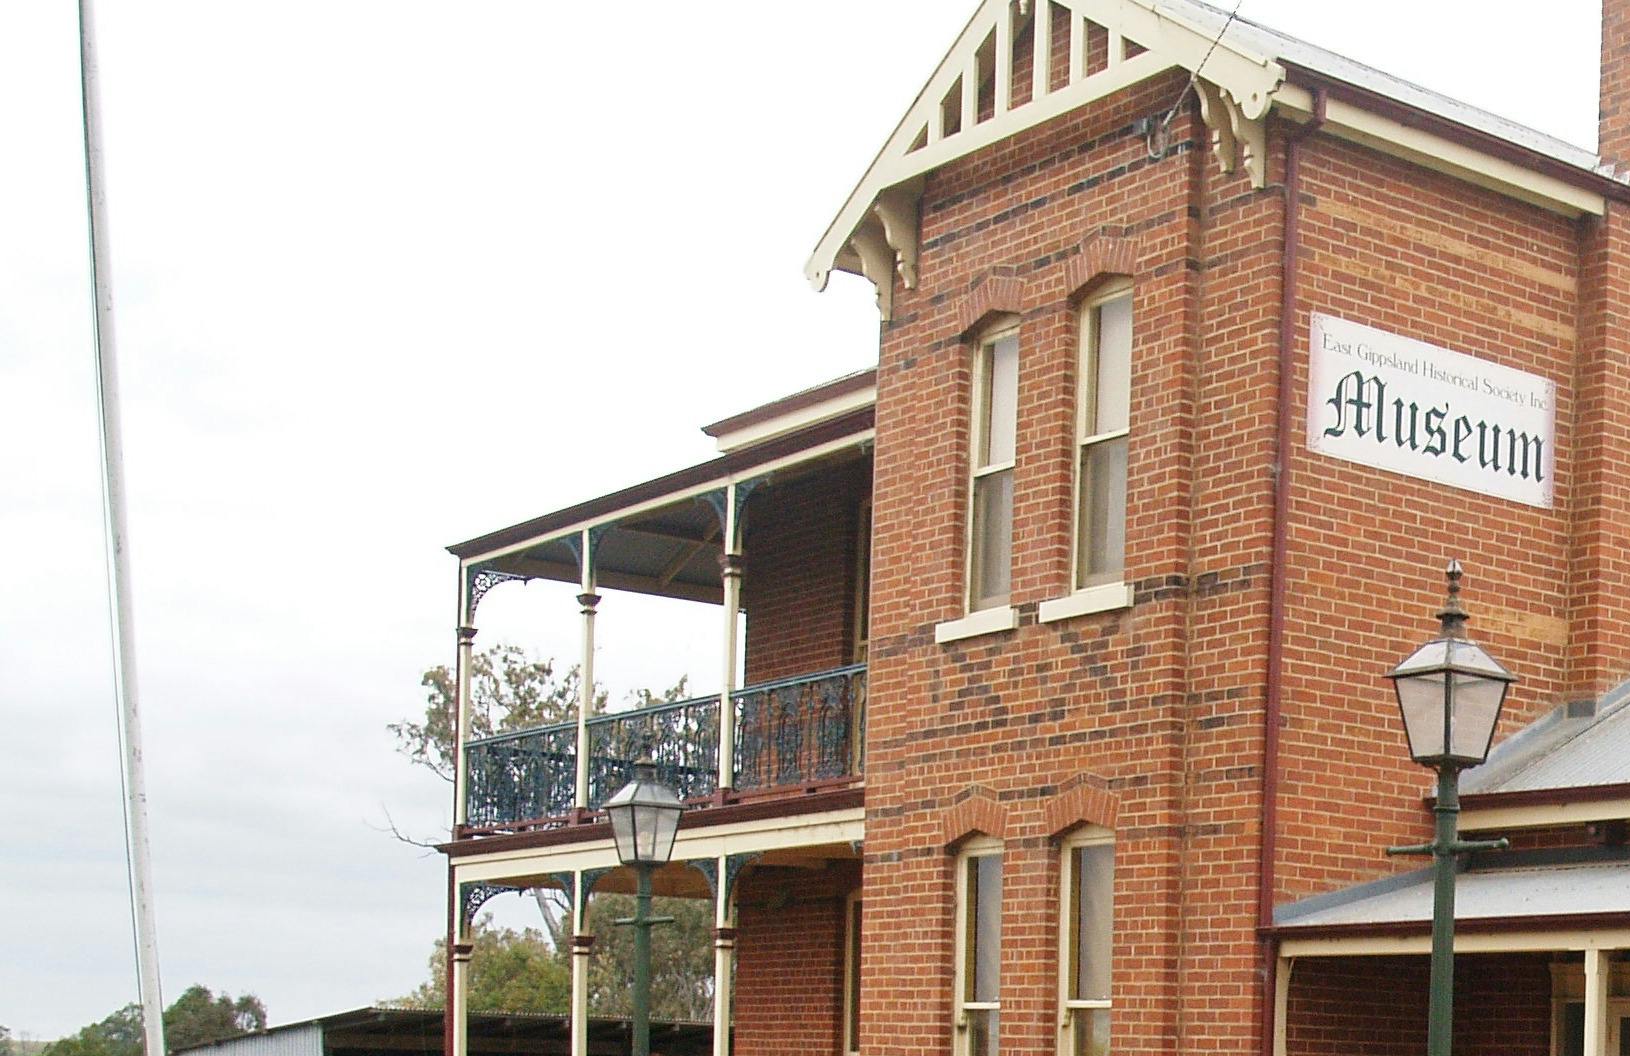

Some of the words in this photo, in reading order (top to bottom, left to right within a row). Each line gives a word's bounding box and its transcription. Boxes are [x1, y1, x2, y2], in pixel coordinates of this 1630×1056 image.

[1323, 333, 1352, 356] East
[1357, 343, 1418, 375] Gippsland
[1423, 361, 1478, 391] Historical
[1482, 378, 1525, 404] Society
[1323, 370, 1545, 483] Museum
